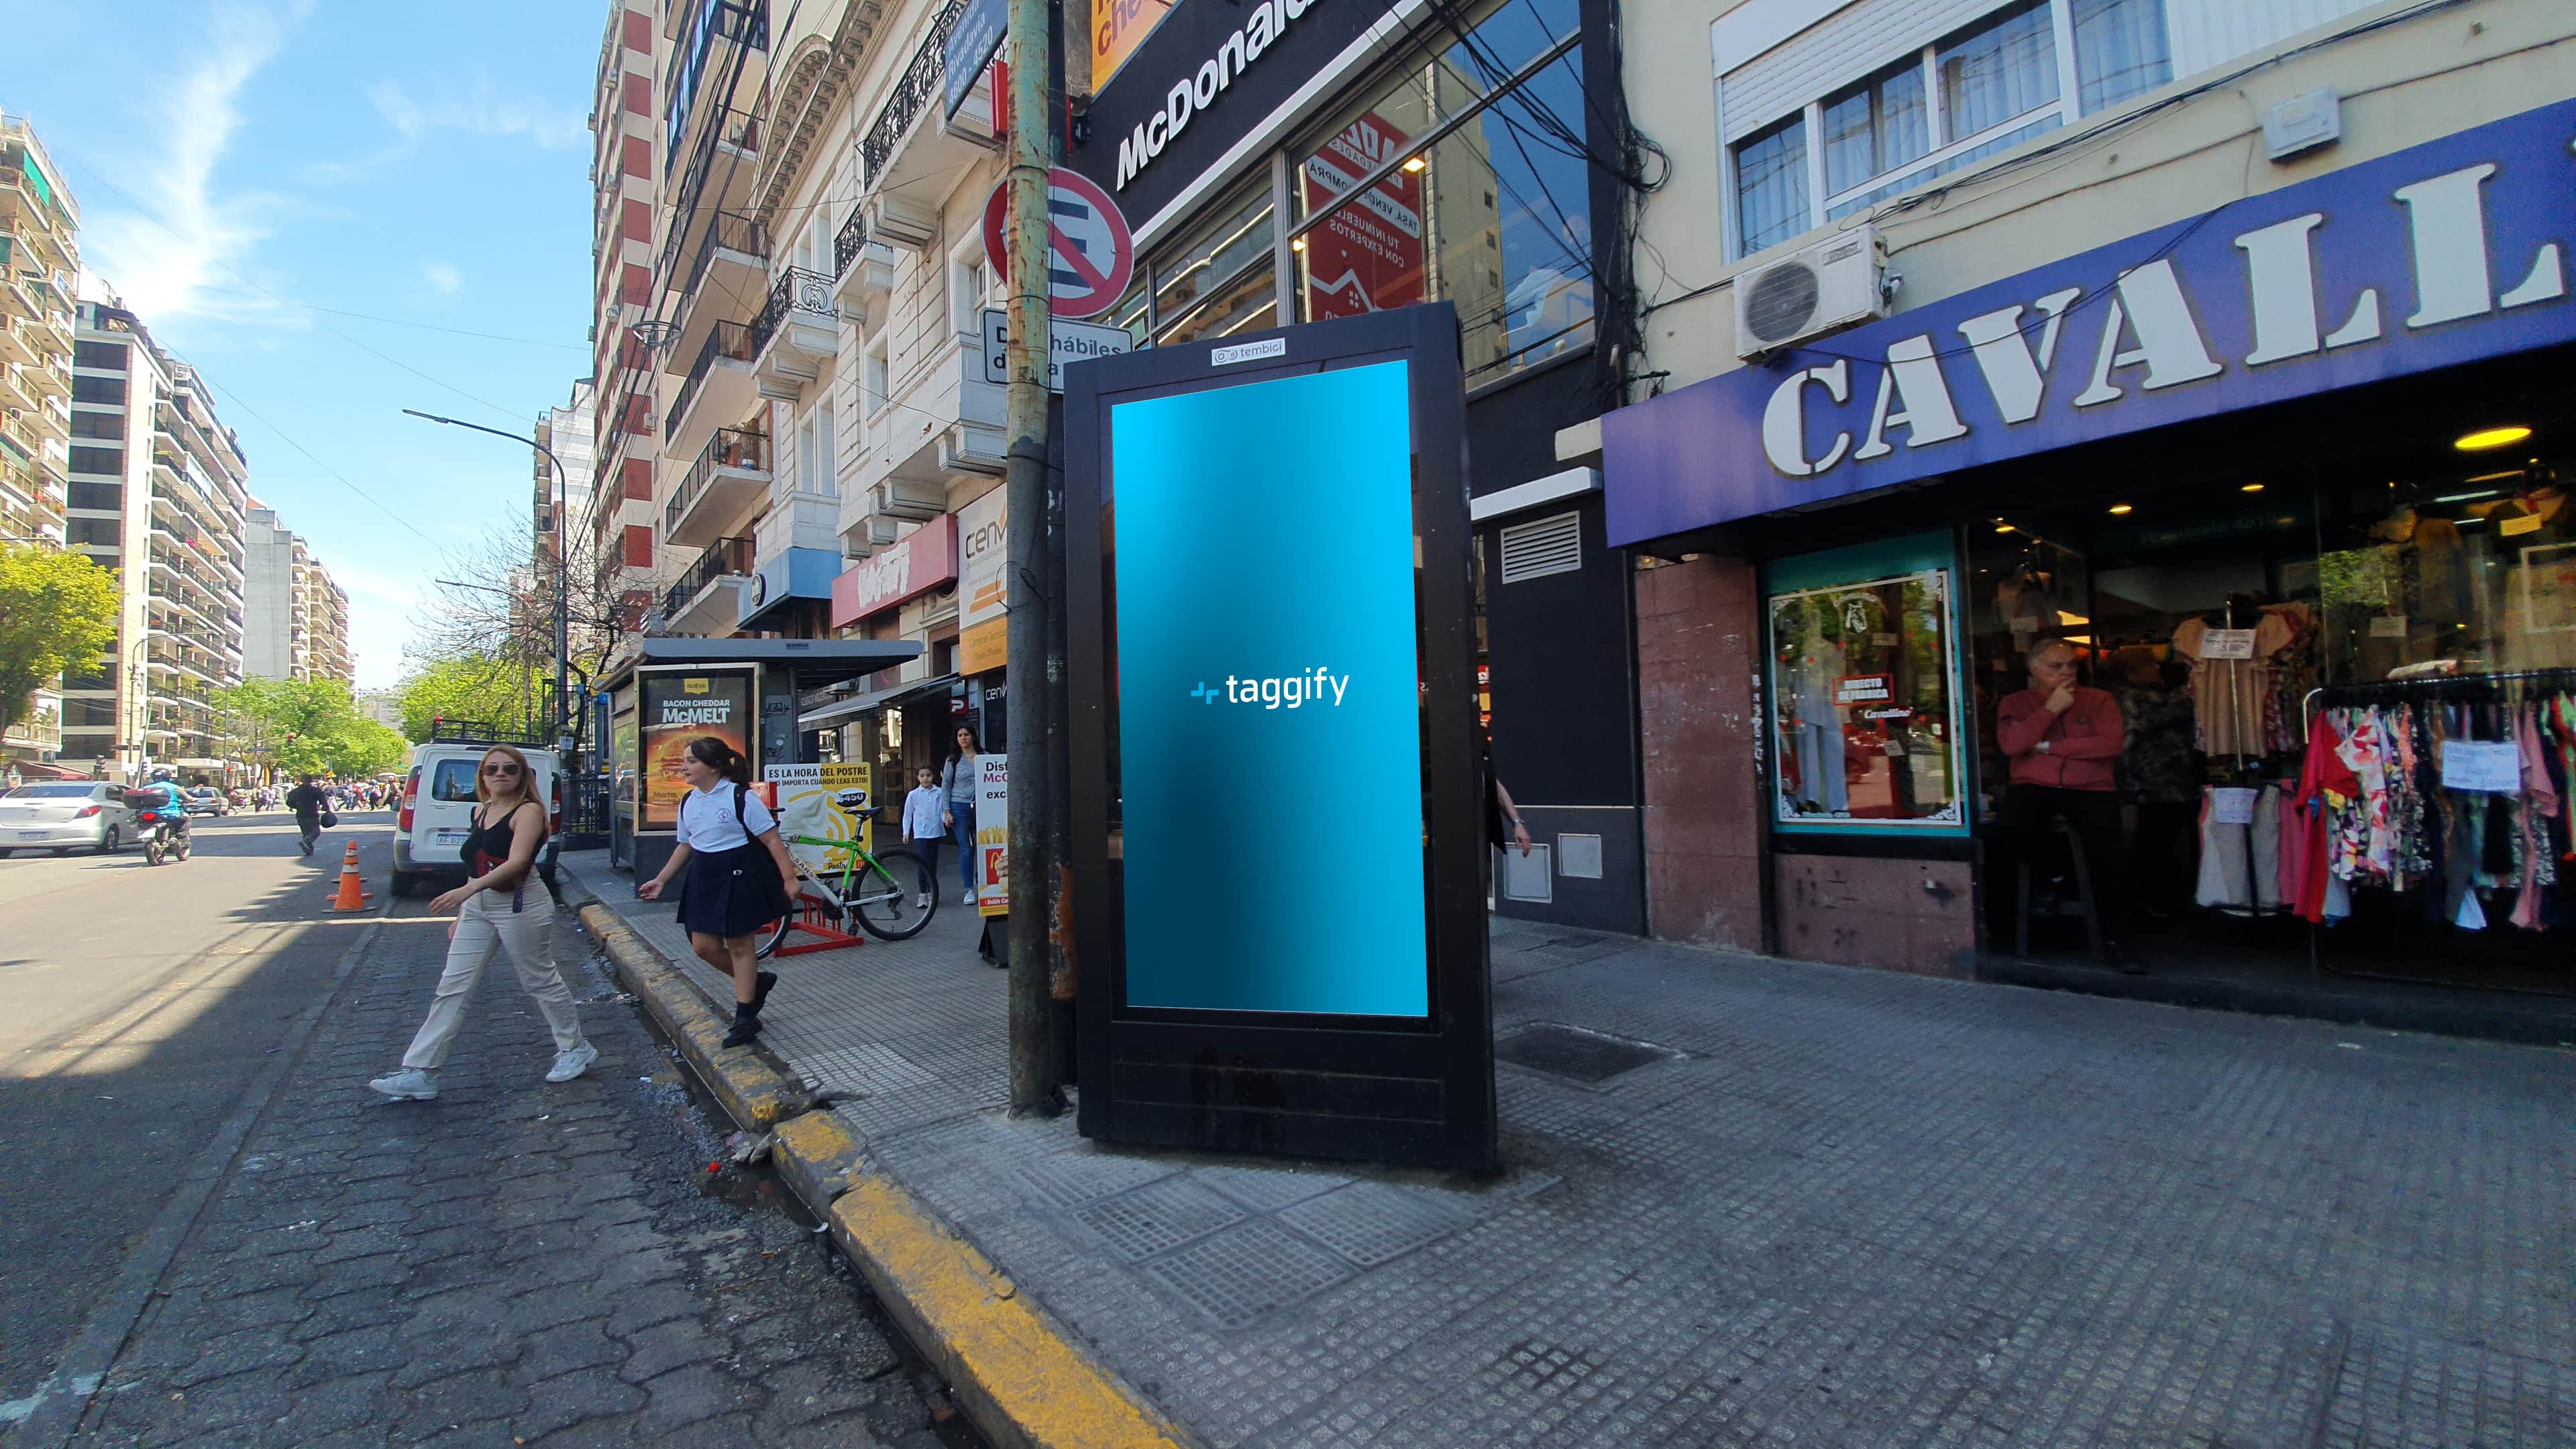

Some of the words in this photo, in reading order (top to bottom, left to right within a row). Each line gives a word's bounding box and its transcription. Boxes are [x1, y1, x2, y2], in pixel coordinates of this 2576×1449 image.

[949, 13, 985, 80] Rivadavia
[950, 67, 967, 103] 4600
[973, 25, 993, 66] 4520
[1762, 139, 2576, 477] CAVALL
[1240, 341, 1282, 357] tembici
[1226, 667, 1350, 709] taggify
[663, 700, 692, 708] BACON
[692, 699, 731, 707] CHEDDAR
[662, 708, 731, 724] McMELT
[769, 769, 779, 778] ES
[782, 769, 792, 778] LA
[794, 768, 818, 777] HORA
[820, 767, 834, 776] DEL
[837, 767, 867, 775] POSTRE
[810, 777, 837, 786] CUÁNDO
